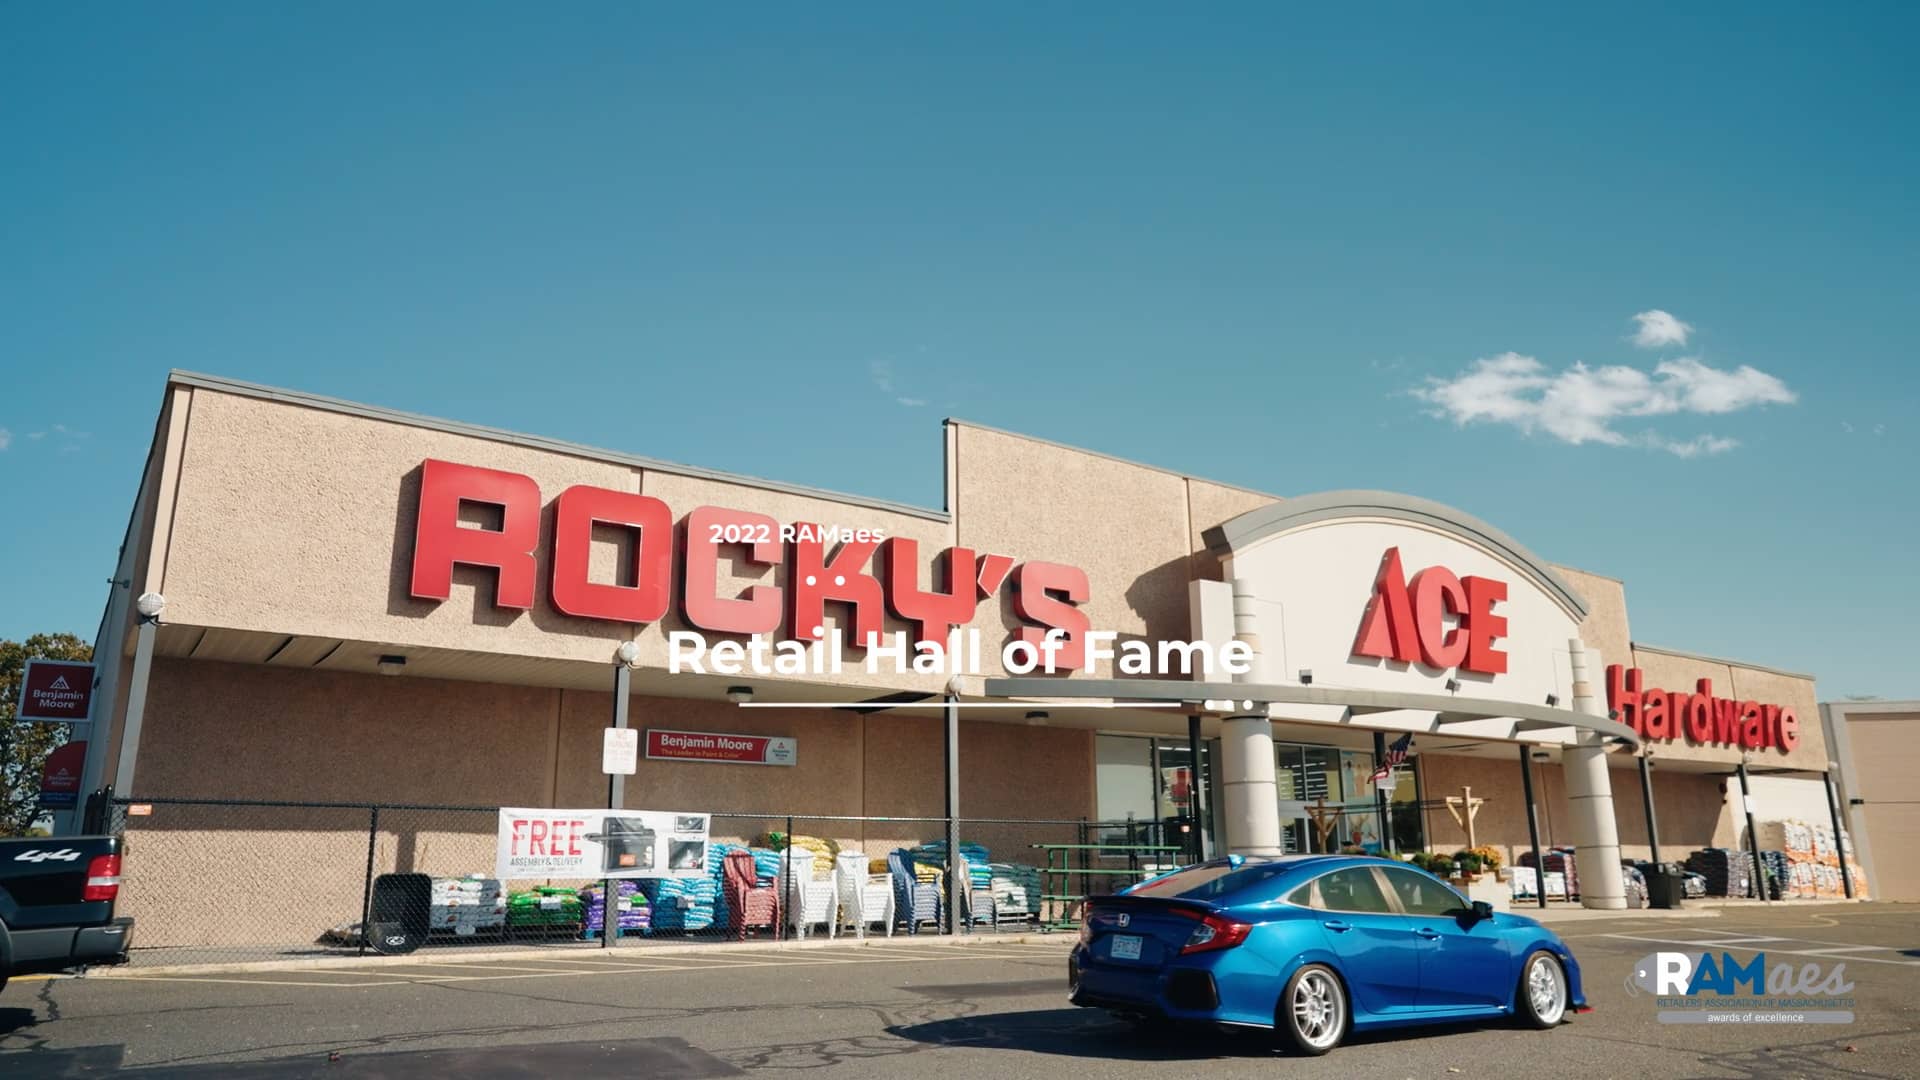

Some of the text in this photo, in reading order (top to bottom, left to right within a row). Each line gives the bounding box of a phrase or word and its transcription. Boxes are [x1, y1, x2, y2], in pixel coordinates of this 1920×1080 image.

[411, 458, 1090, 671] ROCKY'S
[1353, 546, 1508, 674] ACE
[32, 689, 84, 700] Benjamin
[39, 699, 75, 709] Moore
[1606, 664, 1800, 752] Hardware
[661, 734, 753, 751] Benjamin Moore
[511, 820, 585, 856] FREE
